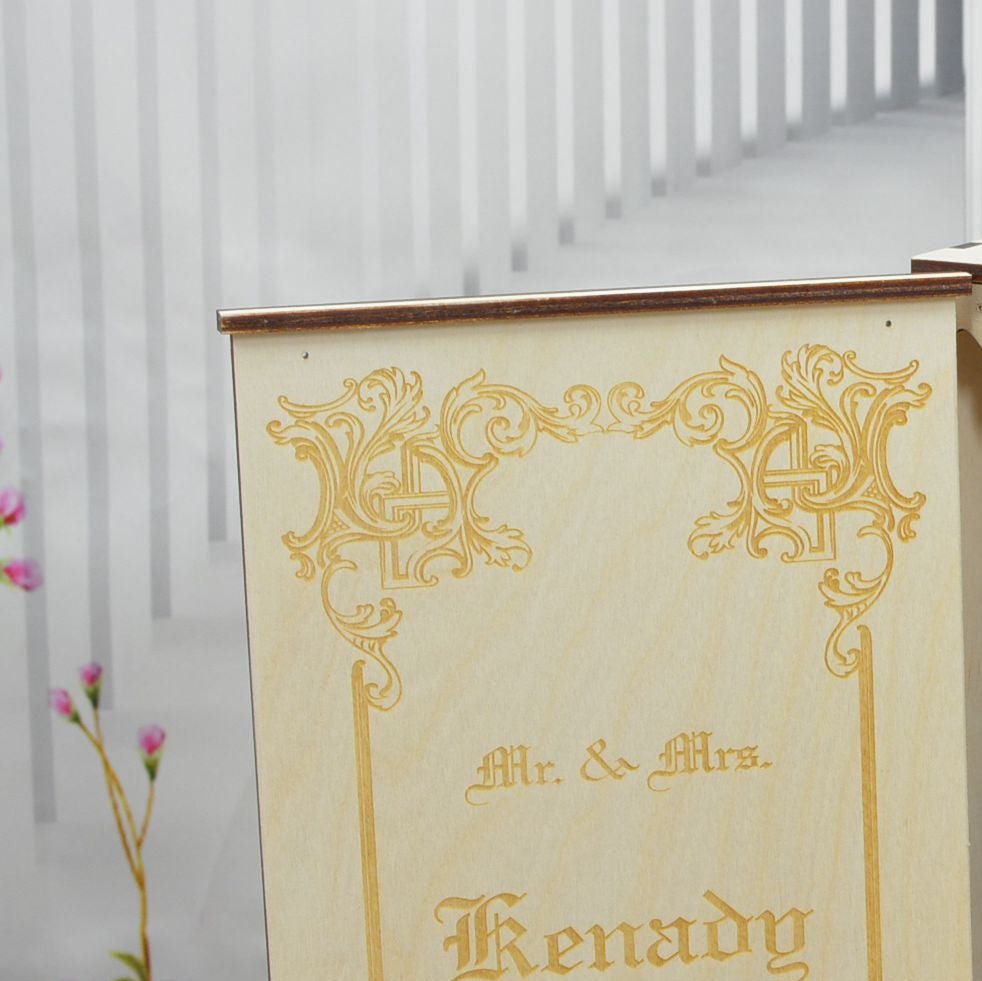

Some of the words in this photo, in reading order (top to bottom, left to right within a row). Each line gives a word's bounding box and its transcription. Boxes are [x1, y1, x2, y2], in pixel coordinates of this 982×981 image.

[465, 744, 563, 807] Mr.
[579, 738, 640, 782] &
[647, 730, 774, 792] Mrs.
